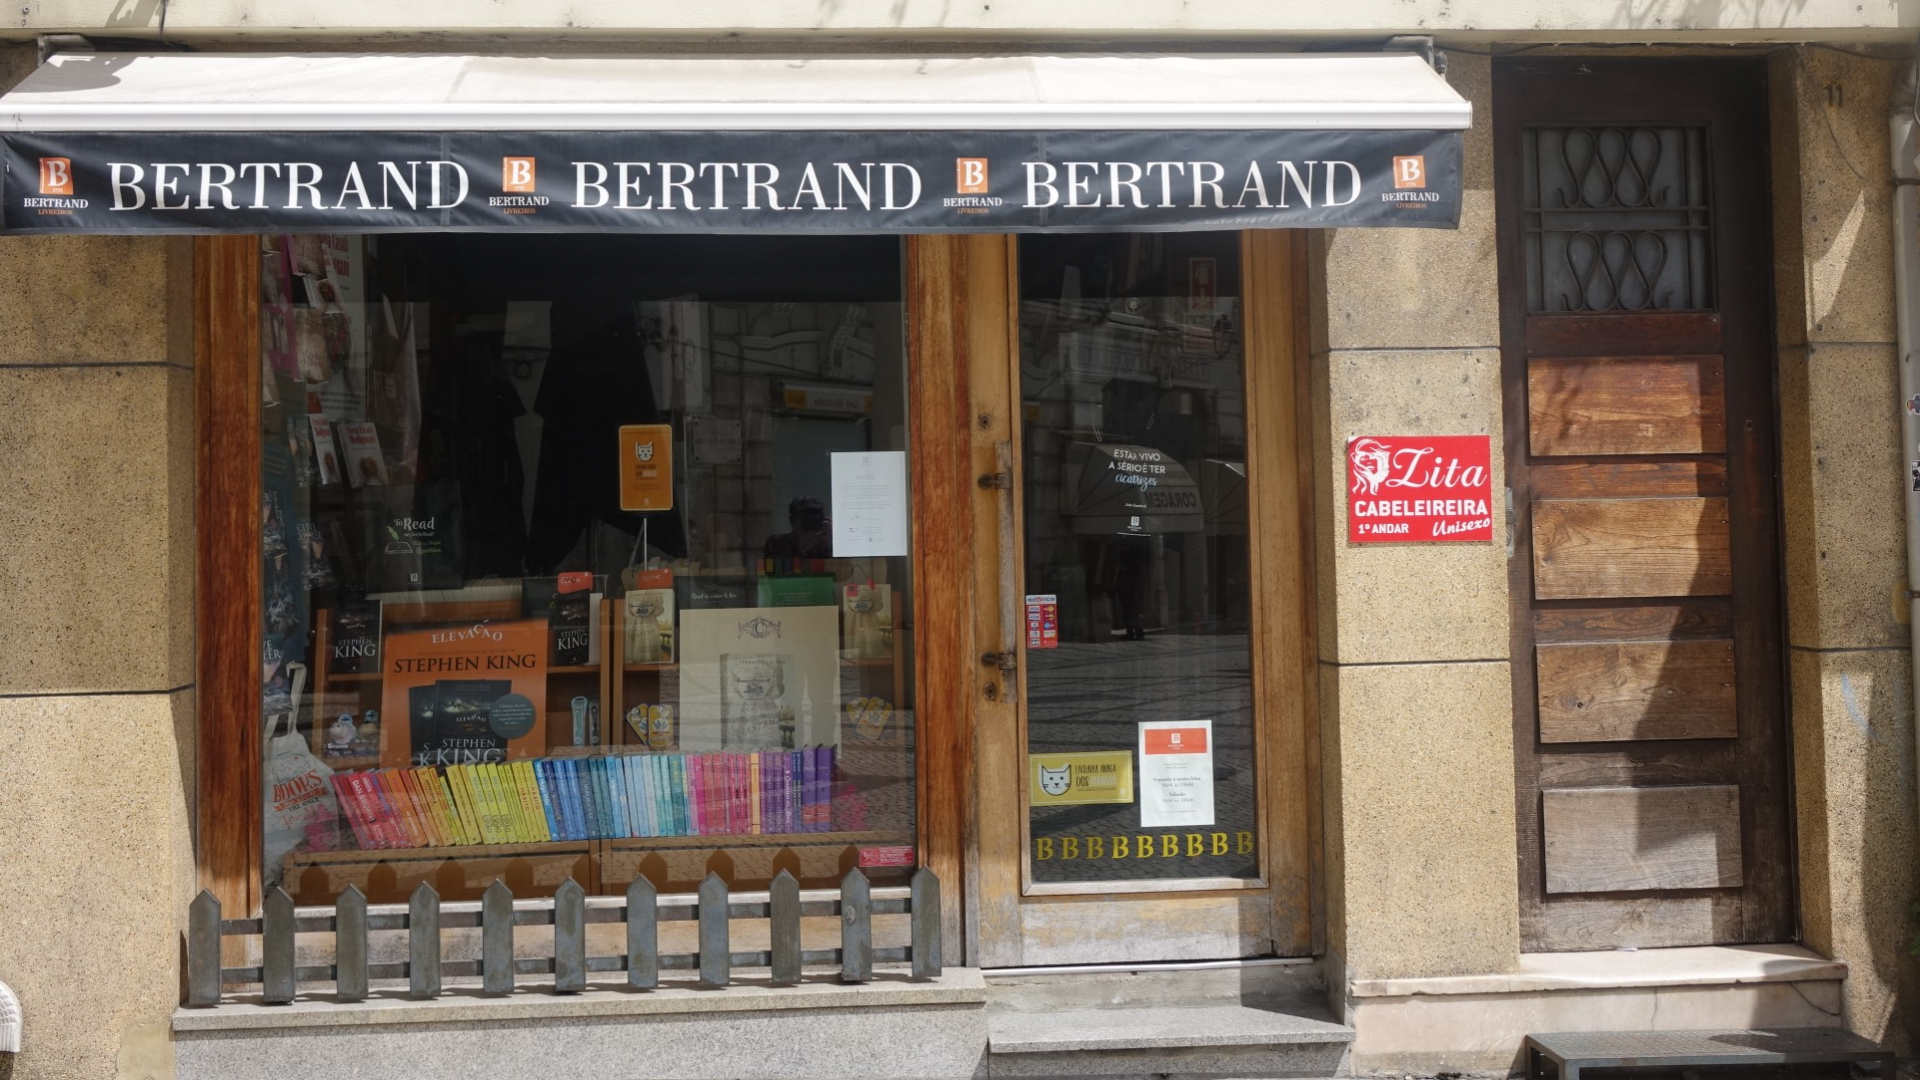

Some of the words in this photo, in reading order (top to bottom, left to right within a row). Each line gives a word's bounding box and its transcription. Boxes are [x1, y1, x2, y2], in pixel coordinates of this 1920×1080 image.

[1822, 83, 1842, 107] 11
[46, 160, 69, 187] B
[509, 160, 532, 186] B
[963, 160, 984, 186] B
[1399, 158, 1421, 182] B
[106, 160, 470, 212] BERTRAND
[571, 161, 922, 211] BERTRAND
[1021, 160, 1362, 209] BERTRAND
[23, 197, 89, 209] BERTRAND
[489, 195, 550, 207] BERTRAND
[943, 196, 1003, 207] BERTRAND
[1381, 191, 1440, 202] BERTRAND
[1113, 449, 1138, 460] ESTAR
[1138, 452, 1161, 461] VIVO
[1108, 461, 1116, 470] A
[1116, 461, 1142, 472] SÉRIO
[1149, 464, 1166, 474] TER
[1385, 446, 1488, 488] Zita
[1115, 473, 1158, 492] cicatrizes
[1354, 499, 1489, 517] CABELEIREIRA
[403, 516, 435, 531] Read
[1371, 523, 1409, 534] ANDAR
[1432, 517, 1491, 537] Unisexo
[338, 636, 373, 646] STEPHEN
[432, 619, 503, 645] ELEVAÇÃO
[335, 643, 376, 658] KING
[558, 633, 588, 651] KING
[394, 656, 480, 674] STEPHEN
[486, 654, 537, 670] KING
[442, 738, 497, 749] STEPHEN
[435, 747, 502, 766] KING
[272, 768, 322, 803] BOOKS
[1075, 775, 1089, 787] DOS
[352, 779, 363, 794] DAN
[359, 794, 376, 822] BROWN
